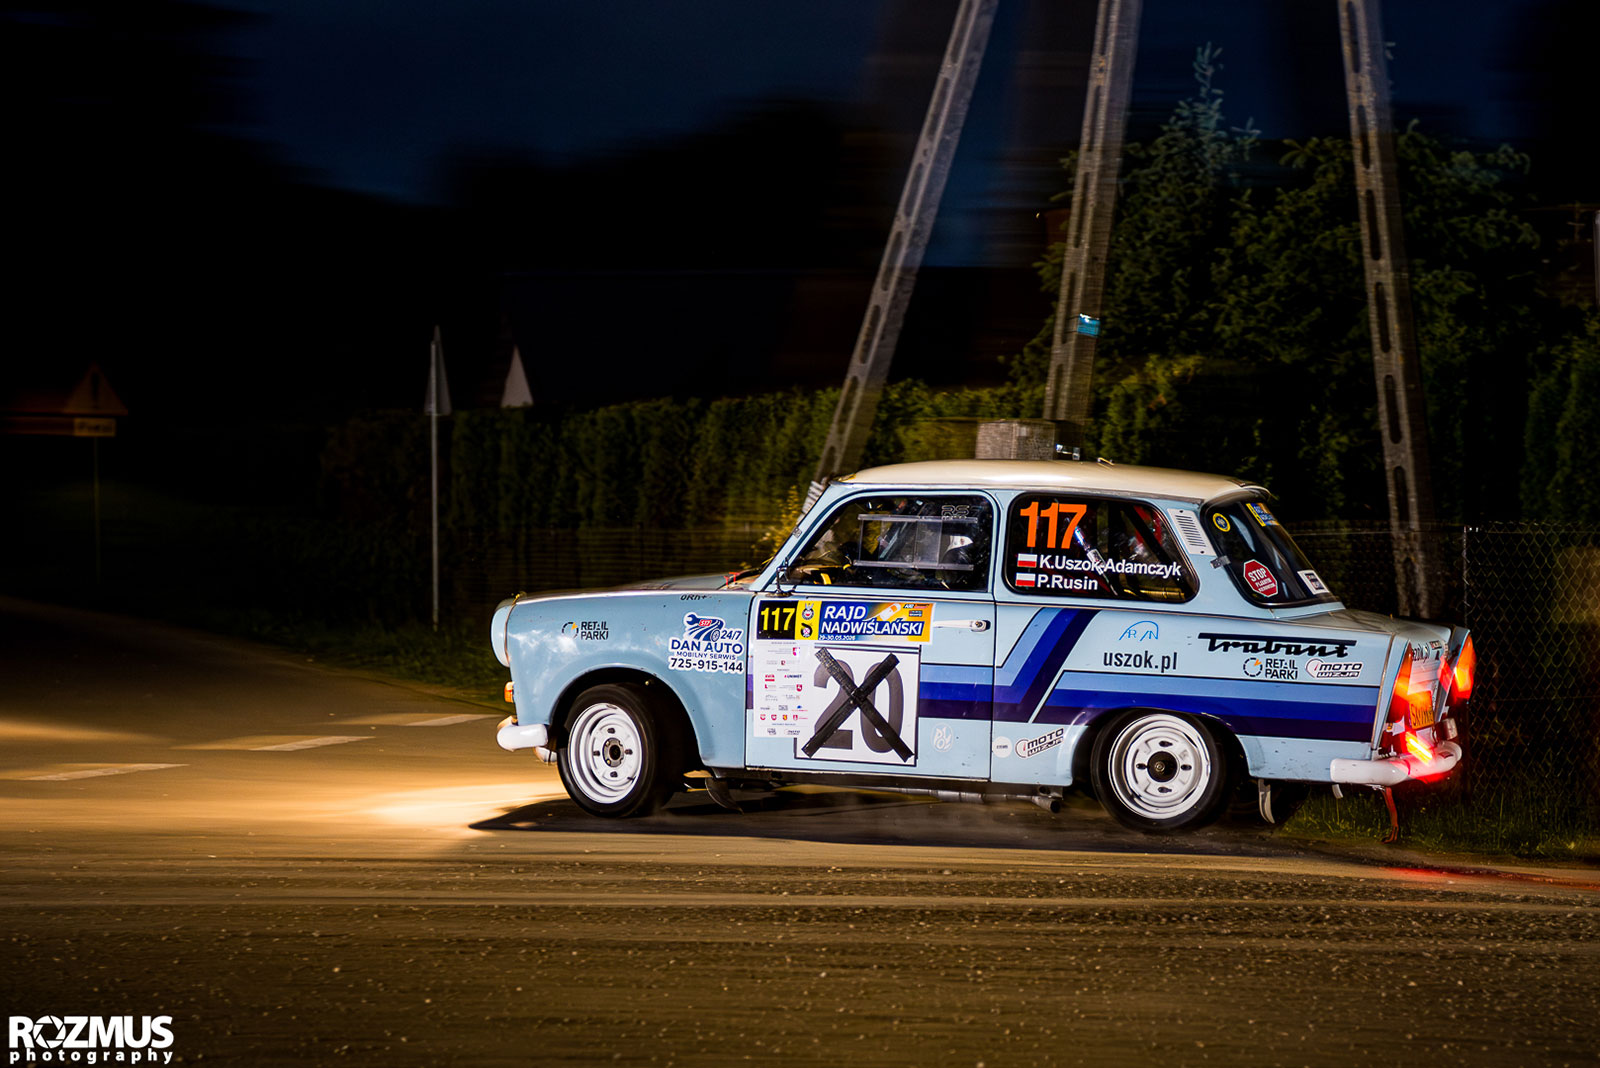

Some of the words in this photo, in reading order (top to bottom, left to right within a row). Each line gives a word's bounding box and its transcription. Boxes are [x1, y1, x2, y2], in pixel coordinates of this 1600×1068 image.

[1019, 501, 1088, 549] 117
[1038, 554, 1182, 578] K.Uszok-Adamczyk
[1037, 573, 1099, 590] P.Rusin
[1247, 567, 1268, 583] STOP
[760, 607, 796, 631] 117
[823, 605, 867, 622] RAJD
[720, 629, 743, 641] 24/7
[820, 618, 924, 635] NADWIŚLAŃSKI
[580, 632, 609, 641] PARKI
[1198, 632, 1358, 658] Trabant
[671, 639, 701, 652] DAN
[704, 642, 744, 655] AUTO
[670, 657, 744, 672] 725-915-144
[677, 651, 708, 659] MOBILNY
[709, 653, 737, 661] SERWIS
[1103, 651, 1178, 673] uszok.pl
[1264, 669, 1299, 680] PARKI
[1319, 663, 1363, 671] MOTO
[813, 659, 905, 754] 20
[1027, 727, 1064, 750] MOTO
